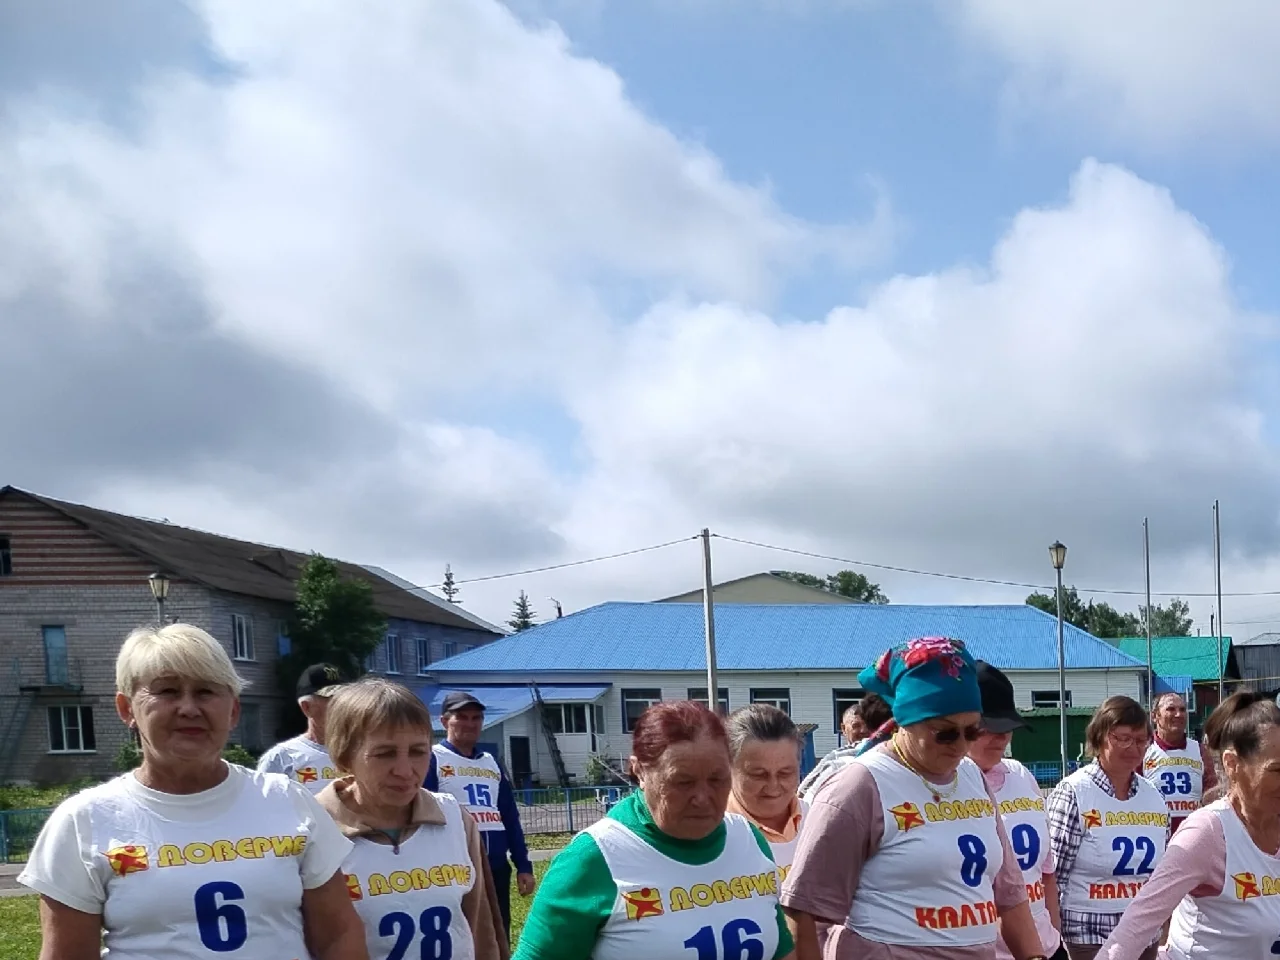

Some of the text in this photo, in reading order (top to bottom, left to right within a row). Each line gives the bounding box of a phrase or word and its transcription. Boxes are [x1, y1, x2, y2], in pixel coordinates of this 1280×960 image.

[463, 783, 492, 807] 15
[1160, 772, 1192, 795] 33
[924, 798, 996, 822] ДОВЕРИ
[157, 835, 307, 868] ДОВЕРИЕ
[958, 834, 987, 887] 8
[1112, 836, 1155, 876] 22
[669, 871, 778, 912] ДОВЕРИЕ
[194, 881, 248, 952] 6
[915, 900, 999, 929] КАЛТА
